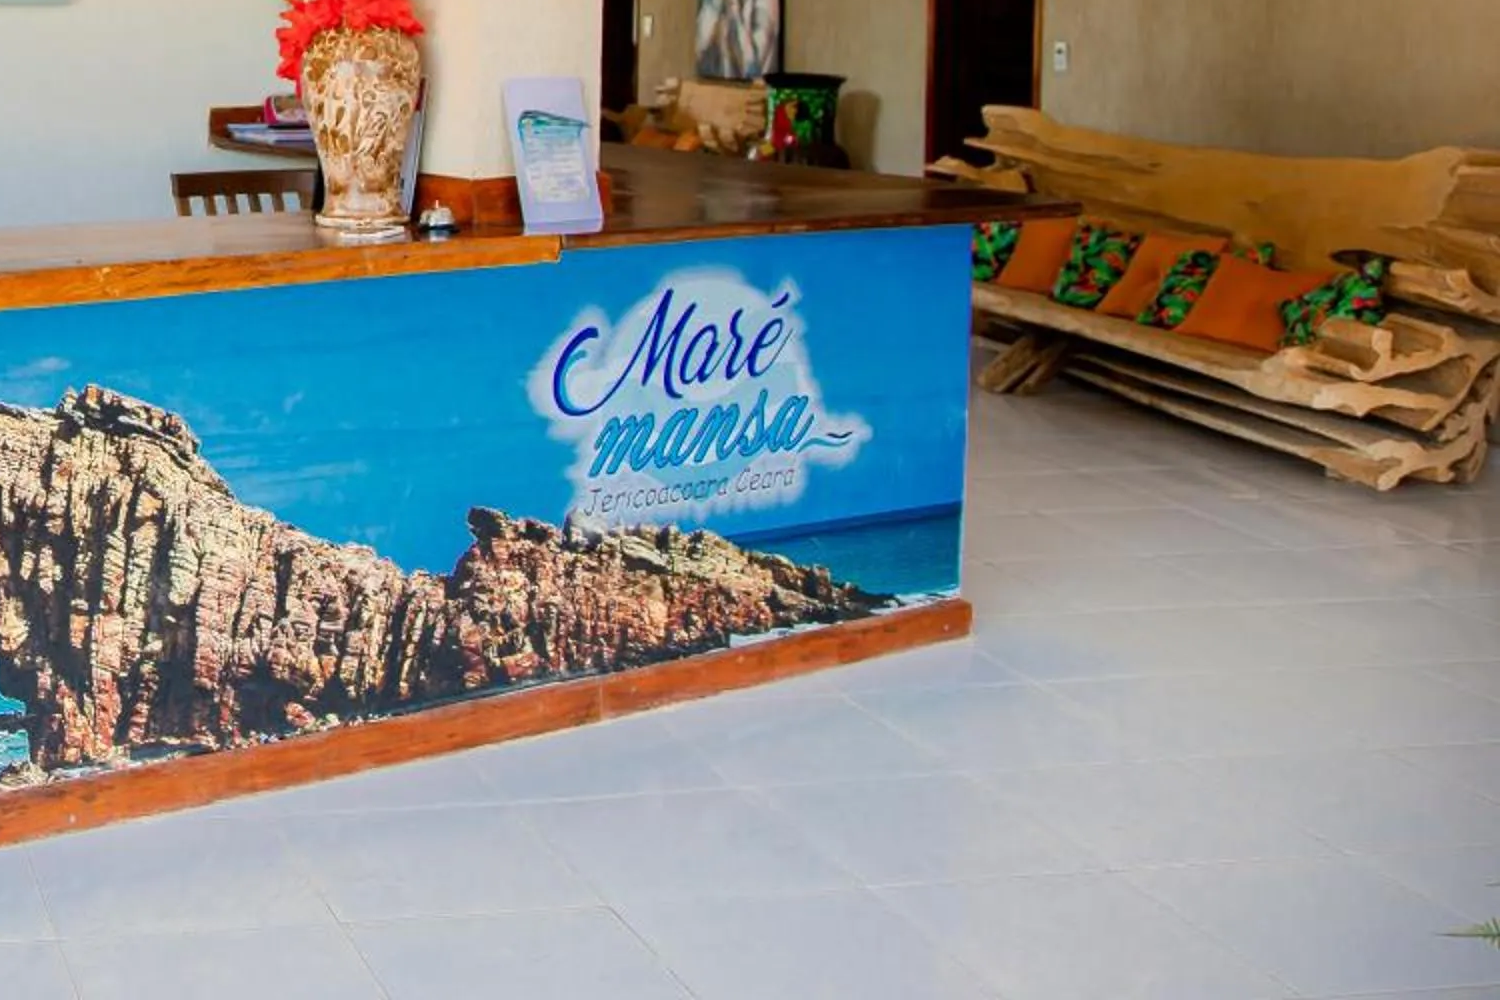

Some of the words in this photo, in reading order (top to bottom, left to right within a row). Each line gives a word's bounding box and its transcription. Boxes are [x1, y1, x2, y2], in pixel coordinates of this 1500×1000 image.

[553, 289, 793, 417] Maré
[588, 389, 816, 477] mansa
[584, 476, 729, 517] Jericoacoara
